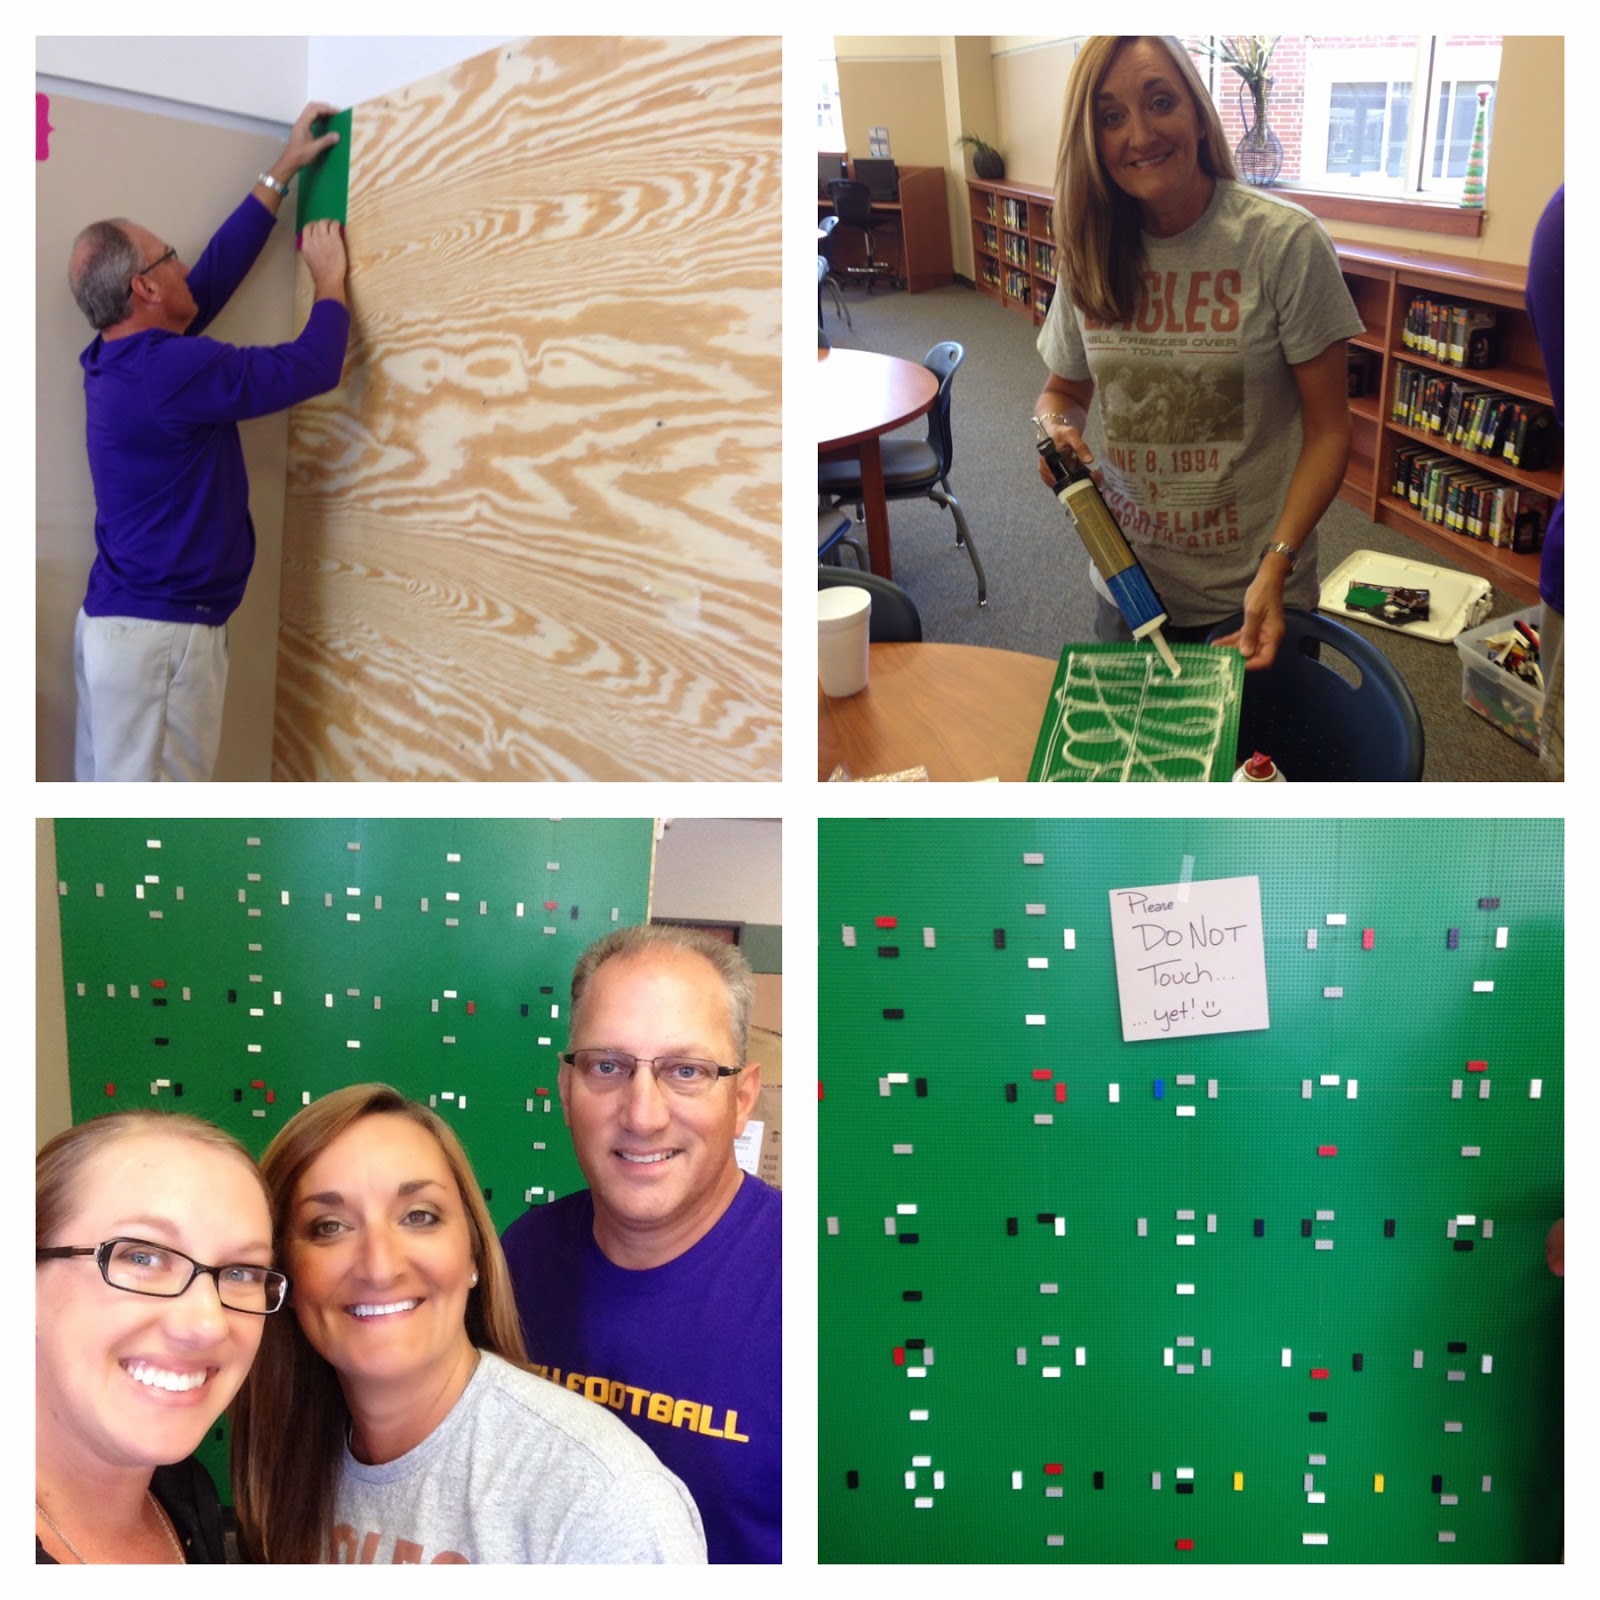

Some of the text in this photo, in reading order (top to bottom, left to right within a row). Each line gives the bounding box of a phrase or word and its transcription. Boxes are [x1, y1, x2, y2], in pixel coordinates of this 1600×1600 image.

[1085, 269, 1242, 334] GLES
[1118, 335, 1188, 347] FREEZES
[1192, 337, 1238, 348] OVER
[1131, 347, 1174, 358] TOUR
[1107, 447, 1219, 475] UNE 8, 1994
[1117, 891, 1175, 914] Please
[565, 1372, 750, 1443] FOOTBALL
